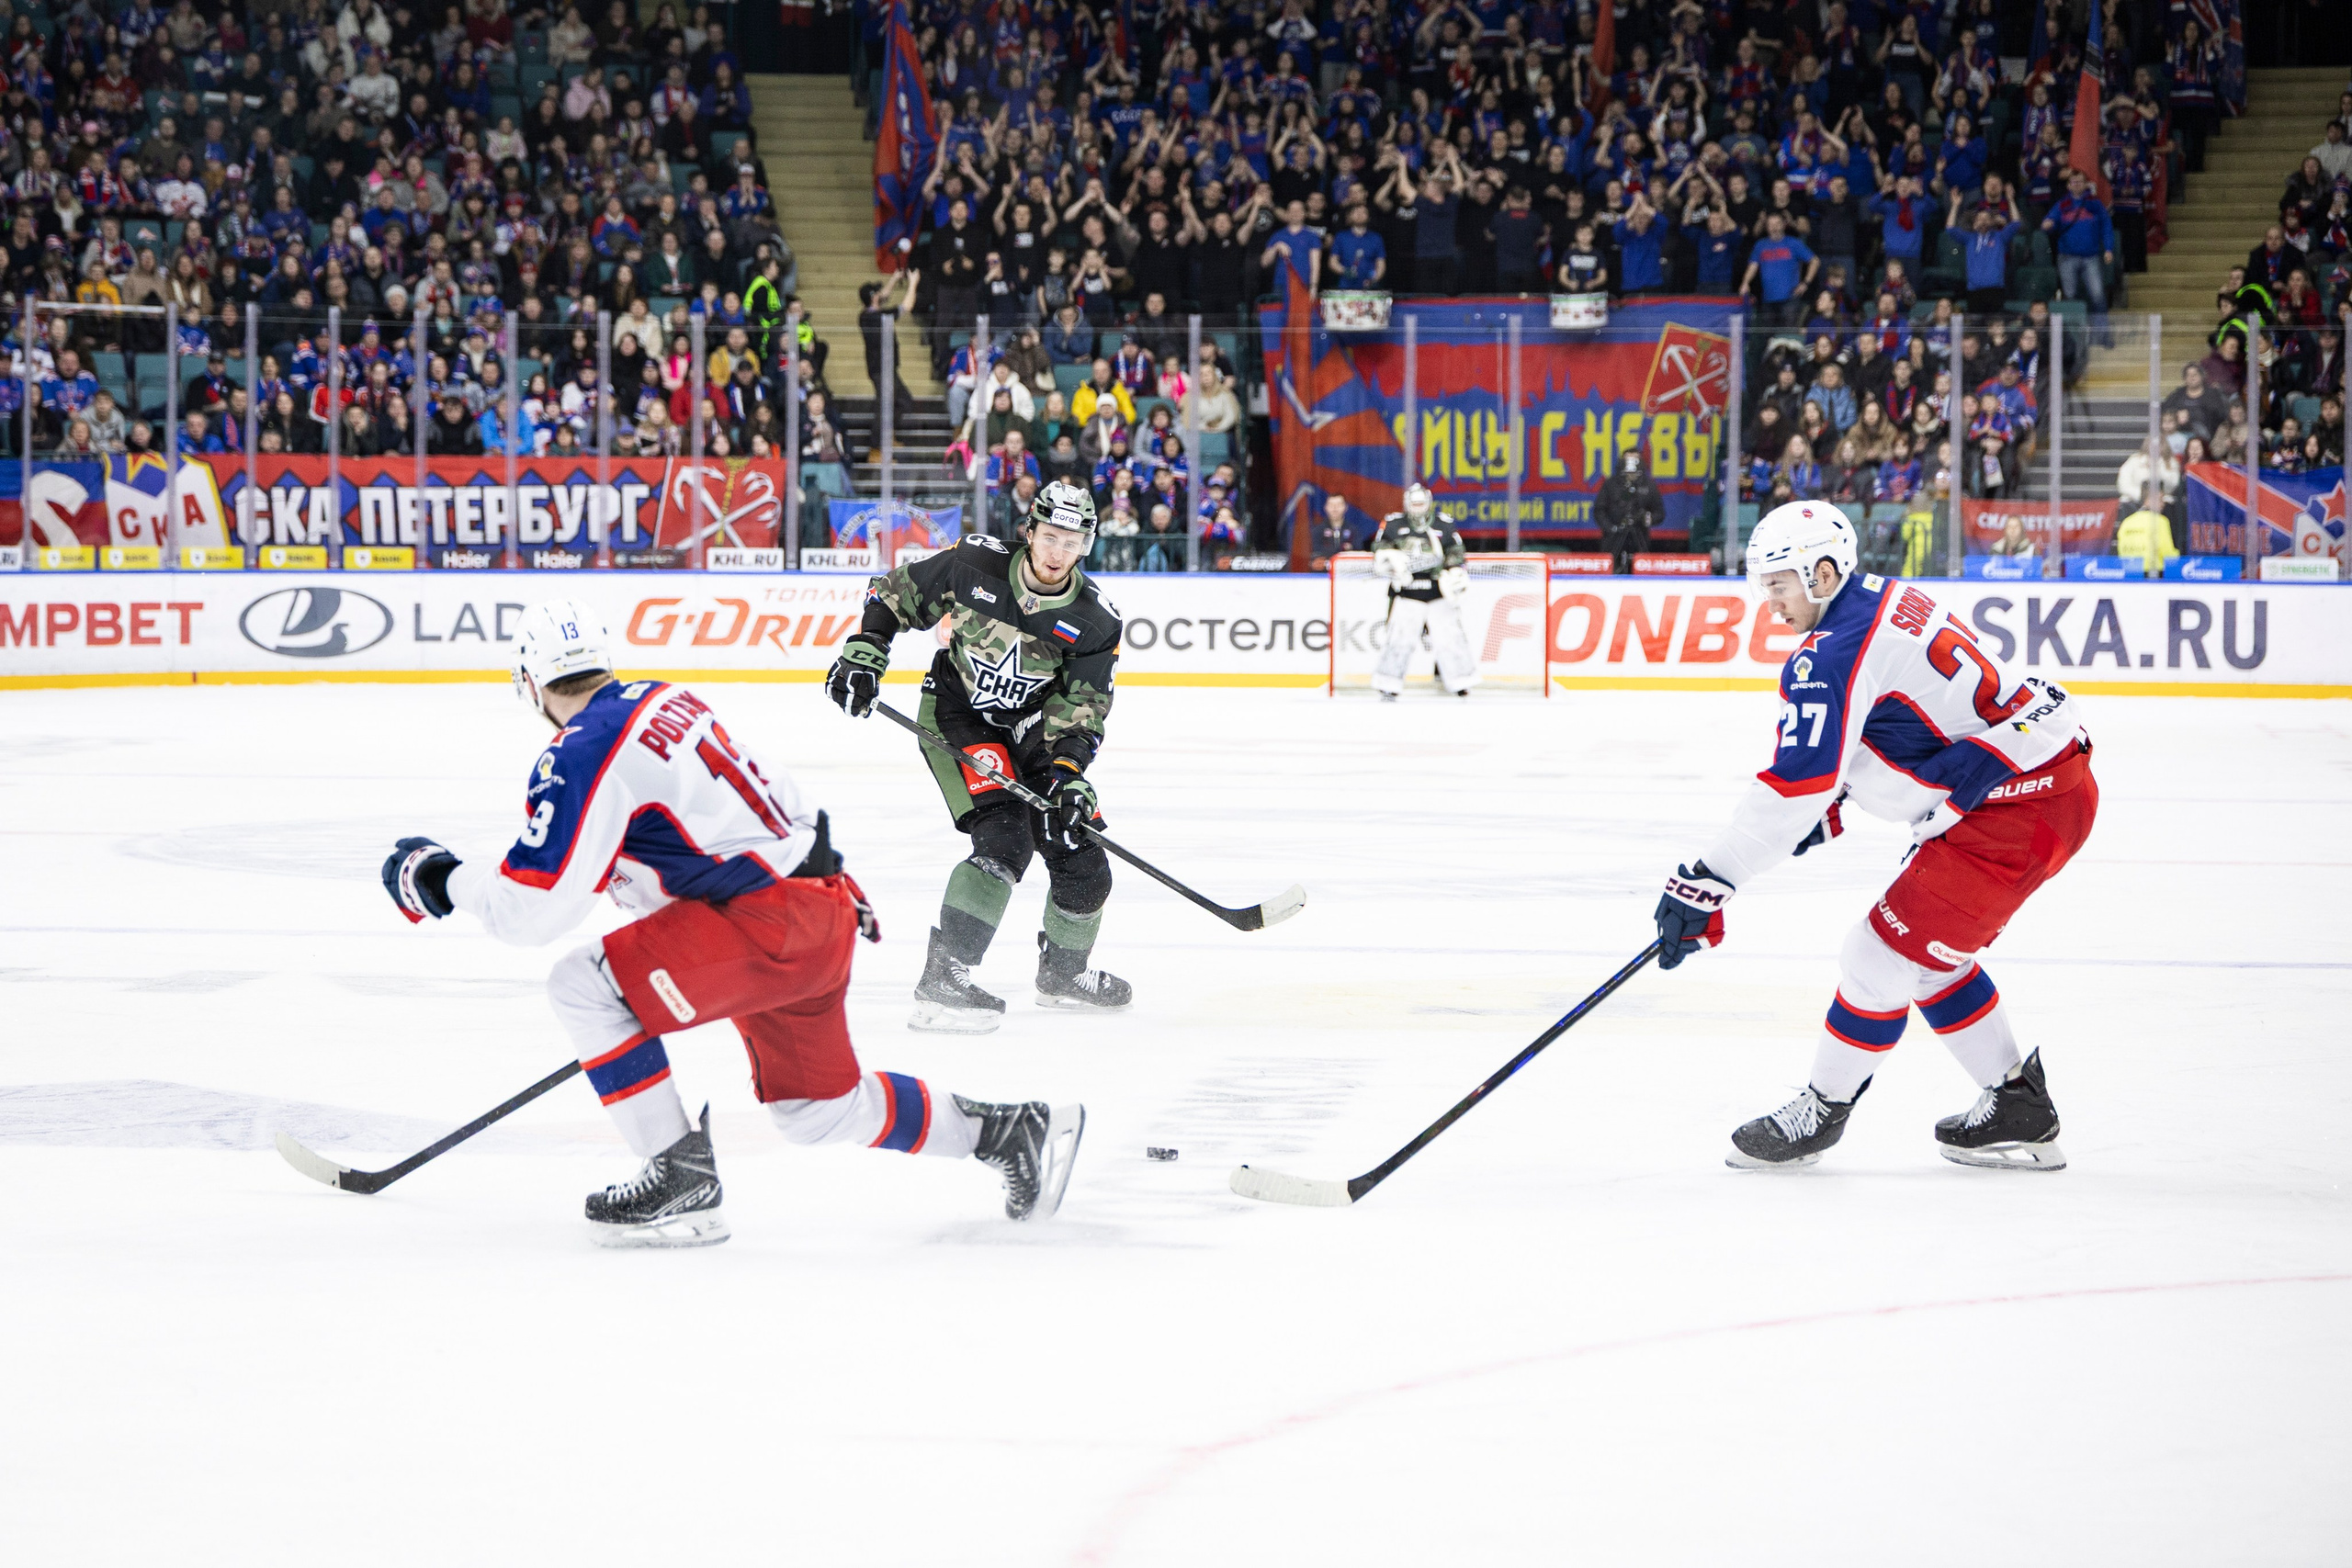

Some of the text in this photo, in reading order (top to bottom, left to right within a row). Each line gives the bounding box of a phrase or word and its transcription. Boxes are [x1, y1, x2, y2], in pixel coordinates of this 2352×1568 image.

[1393, 405, 1525, 482] ЙЦЫ
[1540, 411, 1567, 479] С
[234, 484, 650, 546] СКА ПЕТЕРБУРГ
[2190, 522, 2272, 555] RED-BLE
[442, 549, 492, 569] Haier
[533, 549, 583, 569] Haier
[713, 554, 778, 566] KHL.RU
[807, 554, 872, 567] KHL.RU
[560, 622, 579, 641] 13
[1973, 597, 2267, 669] SKA.RU
[977, 669, 1029, 702] СКА
[1780, 703, 1828, 749] 27
[1665, 876, 1726, 907] CCM
